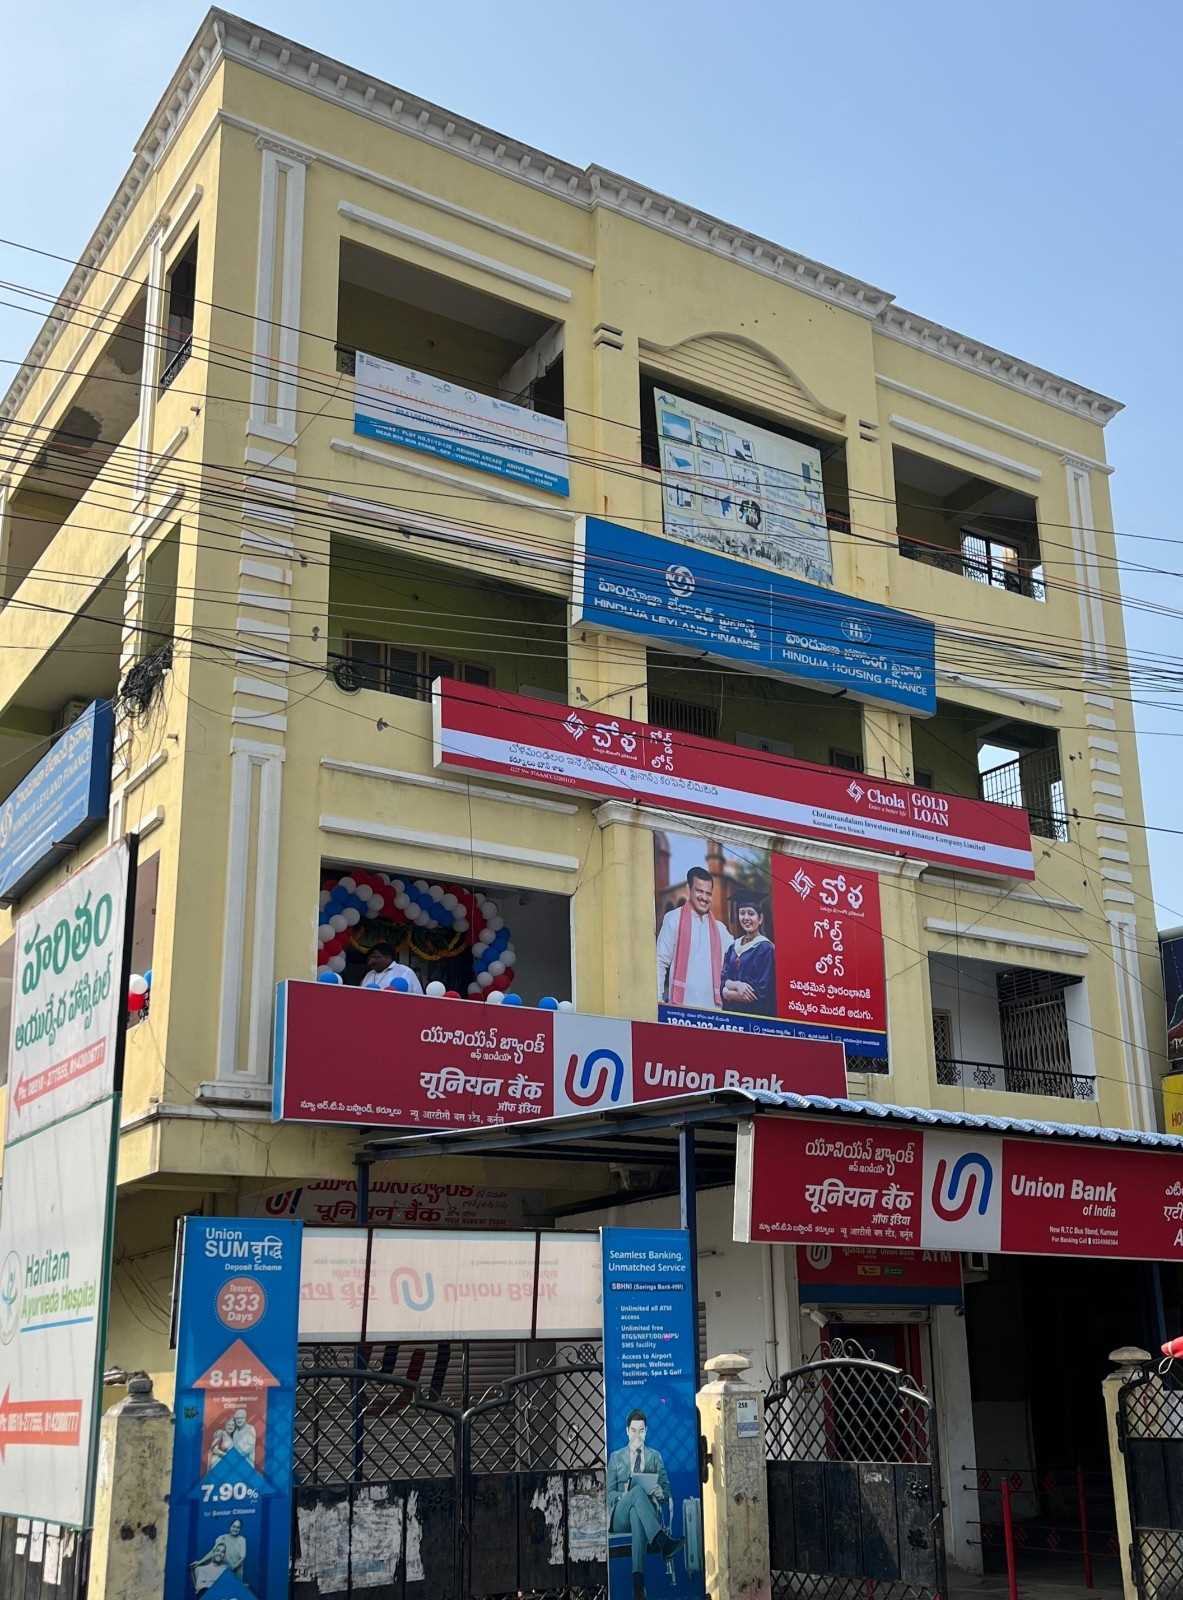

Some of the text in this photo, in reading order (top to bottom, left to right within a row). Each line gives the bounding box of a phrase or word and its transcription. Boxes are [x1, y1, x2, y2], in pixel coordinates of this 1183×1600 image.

[595, 598, 761, 651] HINDUJA LEYLAND FINANCE
[782, 649, 929, 697] HINDUJA HOUSING FINANCE
[867, 787, 905, 810] Chola
[912, 792, 949, 812] GOLD
[913, 808, 949, 827] LOAN
[812, 809, 864, 827] Cholamandalam
[864, 819, 898, 834] Investment
[899, 827, 910, 836] and
[911, 829, 935, 842] Finance
[963, 840, 986, 852] Limited
[813, 919, 844, 953] గోల్డ్
[815, 955, 845, 977] లోన్
[788, 1000, 818, 1016] నమ్మకం
[420, 1025, 546, 1064] యూనియన్ బ్యాంక్
[419, 1066, 545, 1100] यूनियन बैंक
[643, 1060, 784, 1093] Union Bank
[496, 1101, 517, 1113] ऑफ
[805, 1137, 915, 1176] యూనియన్ బ్యాంక్
[804, 1178, 915, 1213] यूनियन बैंक
[1010, 1174, 1118, 1202] Union Bank
[1082, 1204, 1117, 1218] of India
[205, 1228, 243, 1241] Union
[1049, 1225, 1060, 1233] New
[609, 1250, 684, 1262] Seamless Banking,
[25, 1249, 70, 1289] Haritam
[224, 1263, 283, 1272] Deposit Scheme
[608, 1262, 686, 1273] Unmatched Service
[61, 1278, 96, 1315] Hospital
[611, 1283, 633, 1291] SBHNI
[222, 1293, 260, 1313] 333
[227, 1311, 254, 1323] Days
[621, 1324, 664, 1332] Unlimited free
[635, 1342, 657, 1350] facility
[650, 1352, 672, 1361] Airport
[209, 1369, 264, 1388] 8.15%
[650, 1370, 662, 1378] Spa
[669, 1368, 682, 1376] Golf
[201, 1481, 259, 1503] 7.90%
